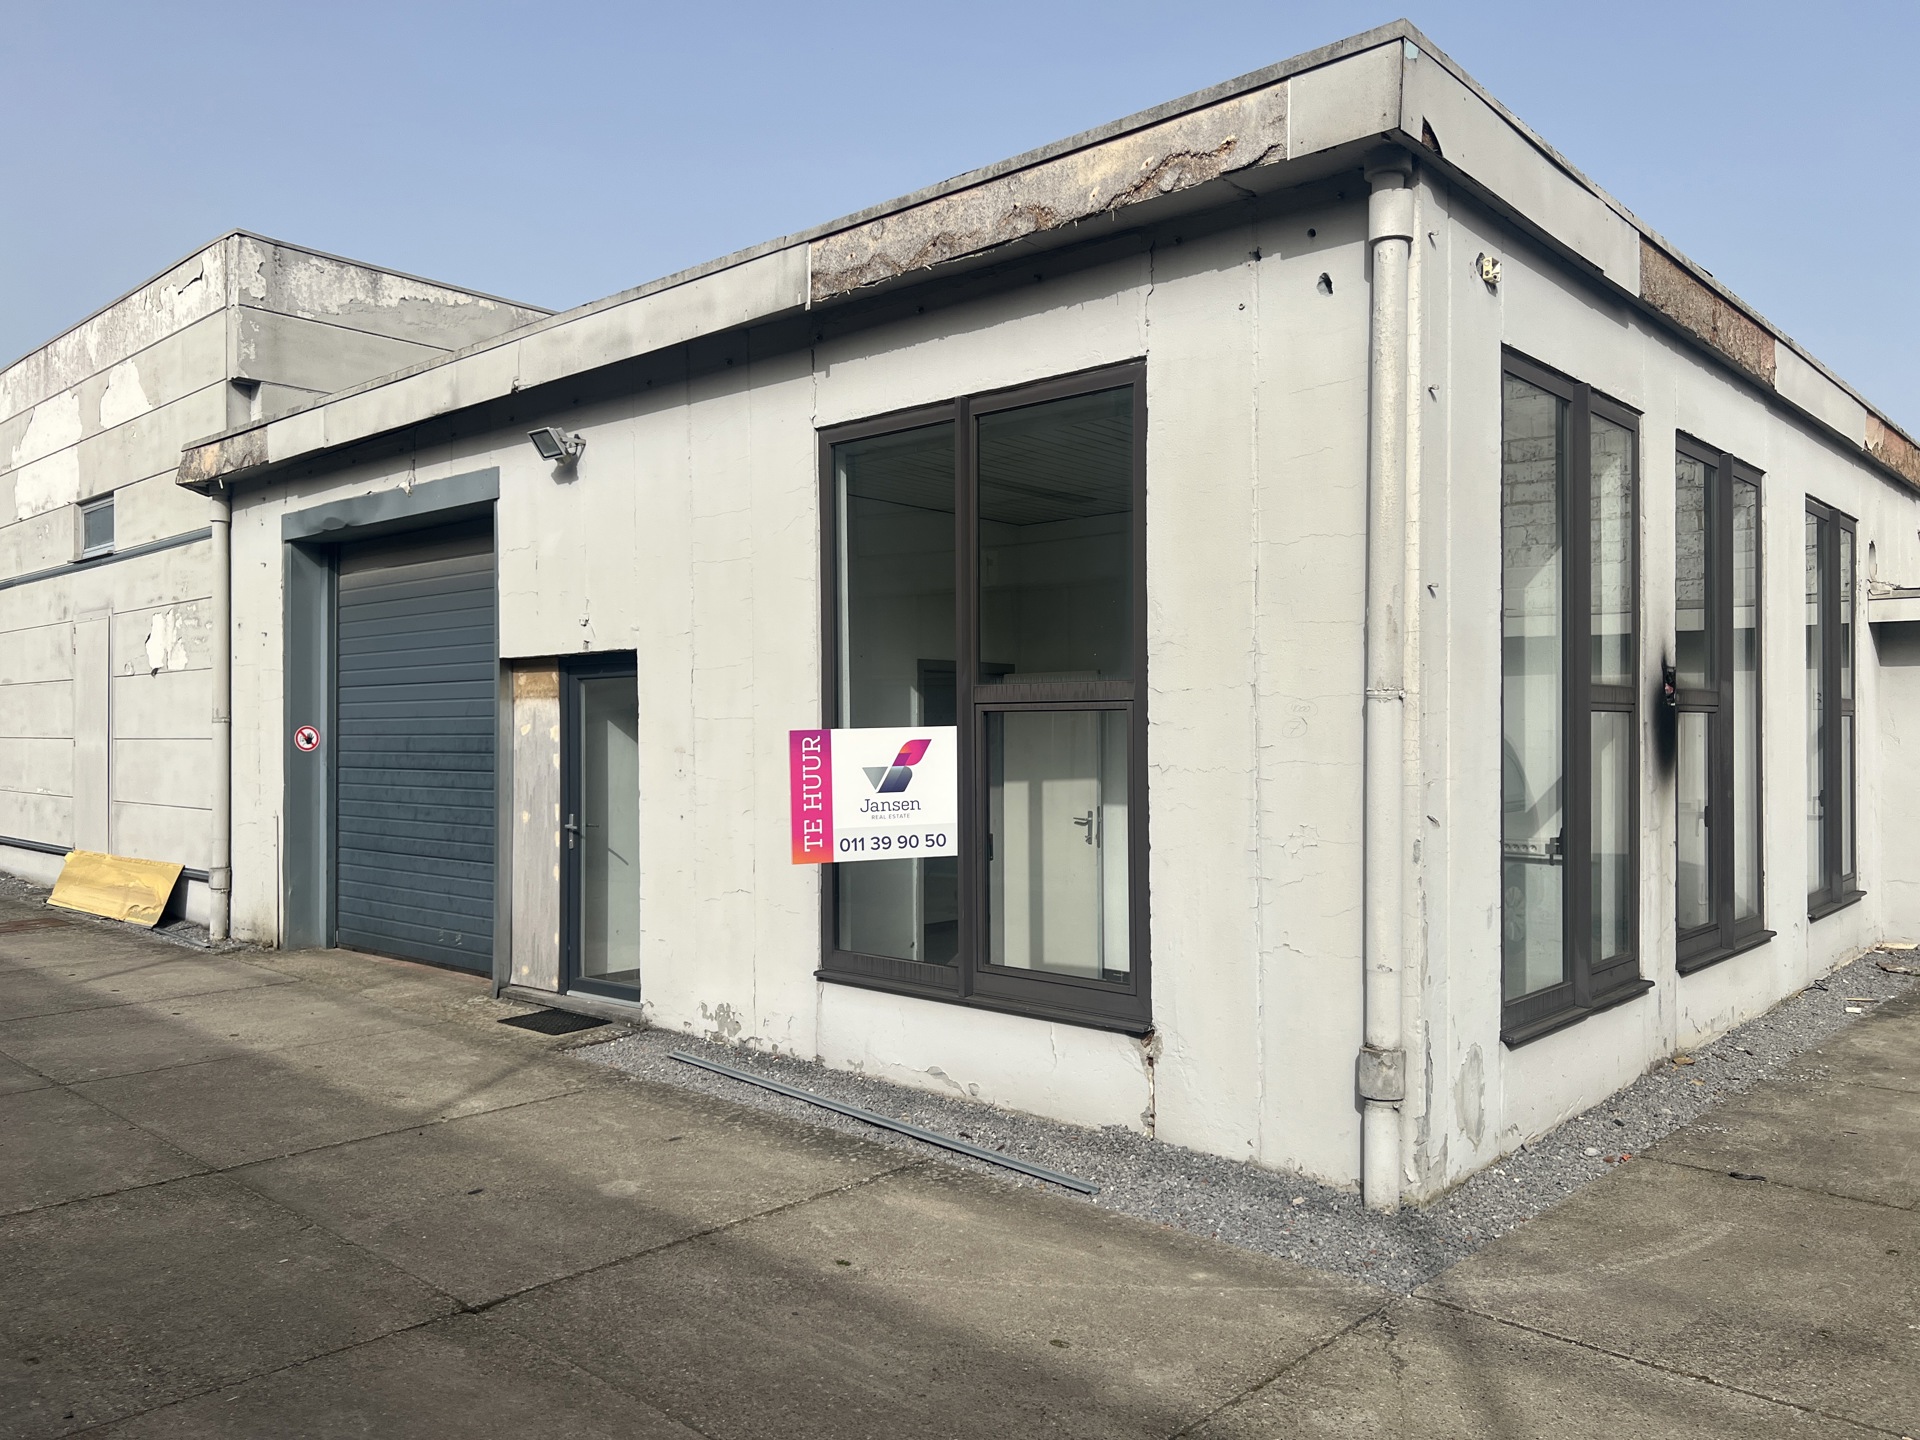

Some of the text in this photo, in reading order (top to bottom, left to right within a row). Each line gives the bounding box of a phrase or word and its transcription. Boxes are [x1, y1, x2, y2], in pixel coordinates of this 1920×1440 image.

[802, 735, 823, 852] TE HUUR
[860, 799, 921, 813] Jansen
[839, 833, 947, 852] 011 39 90 50
